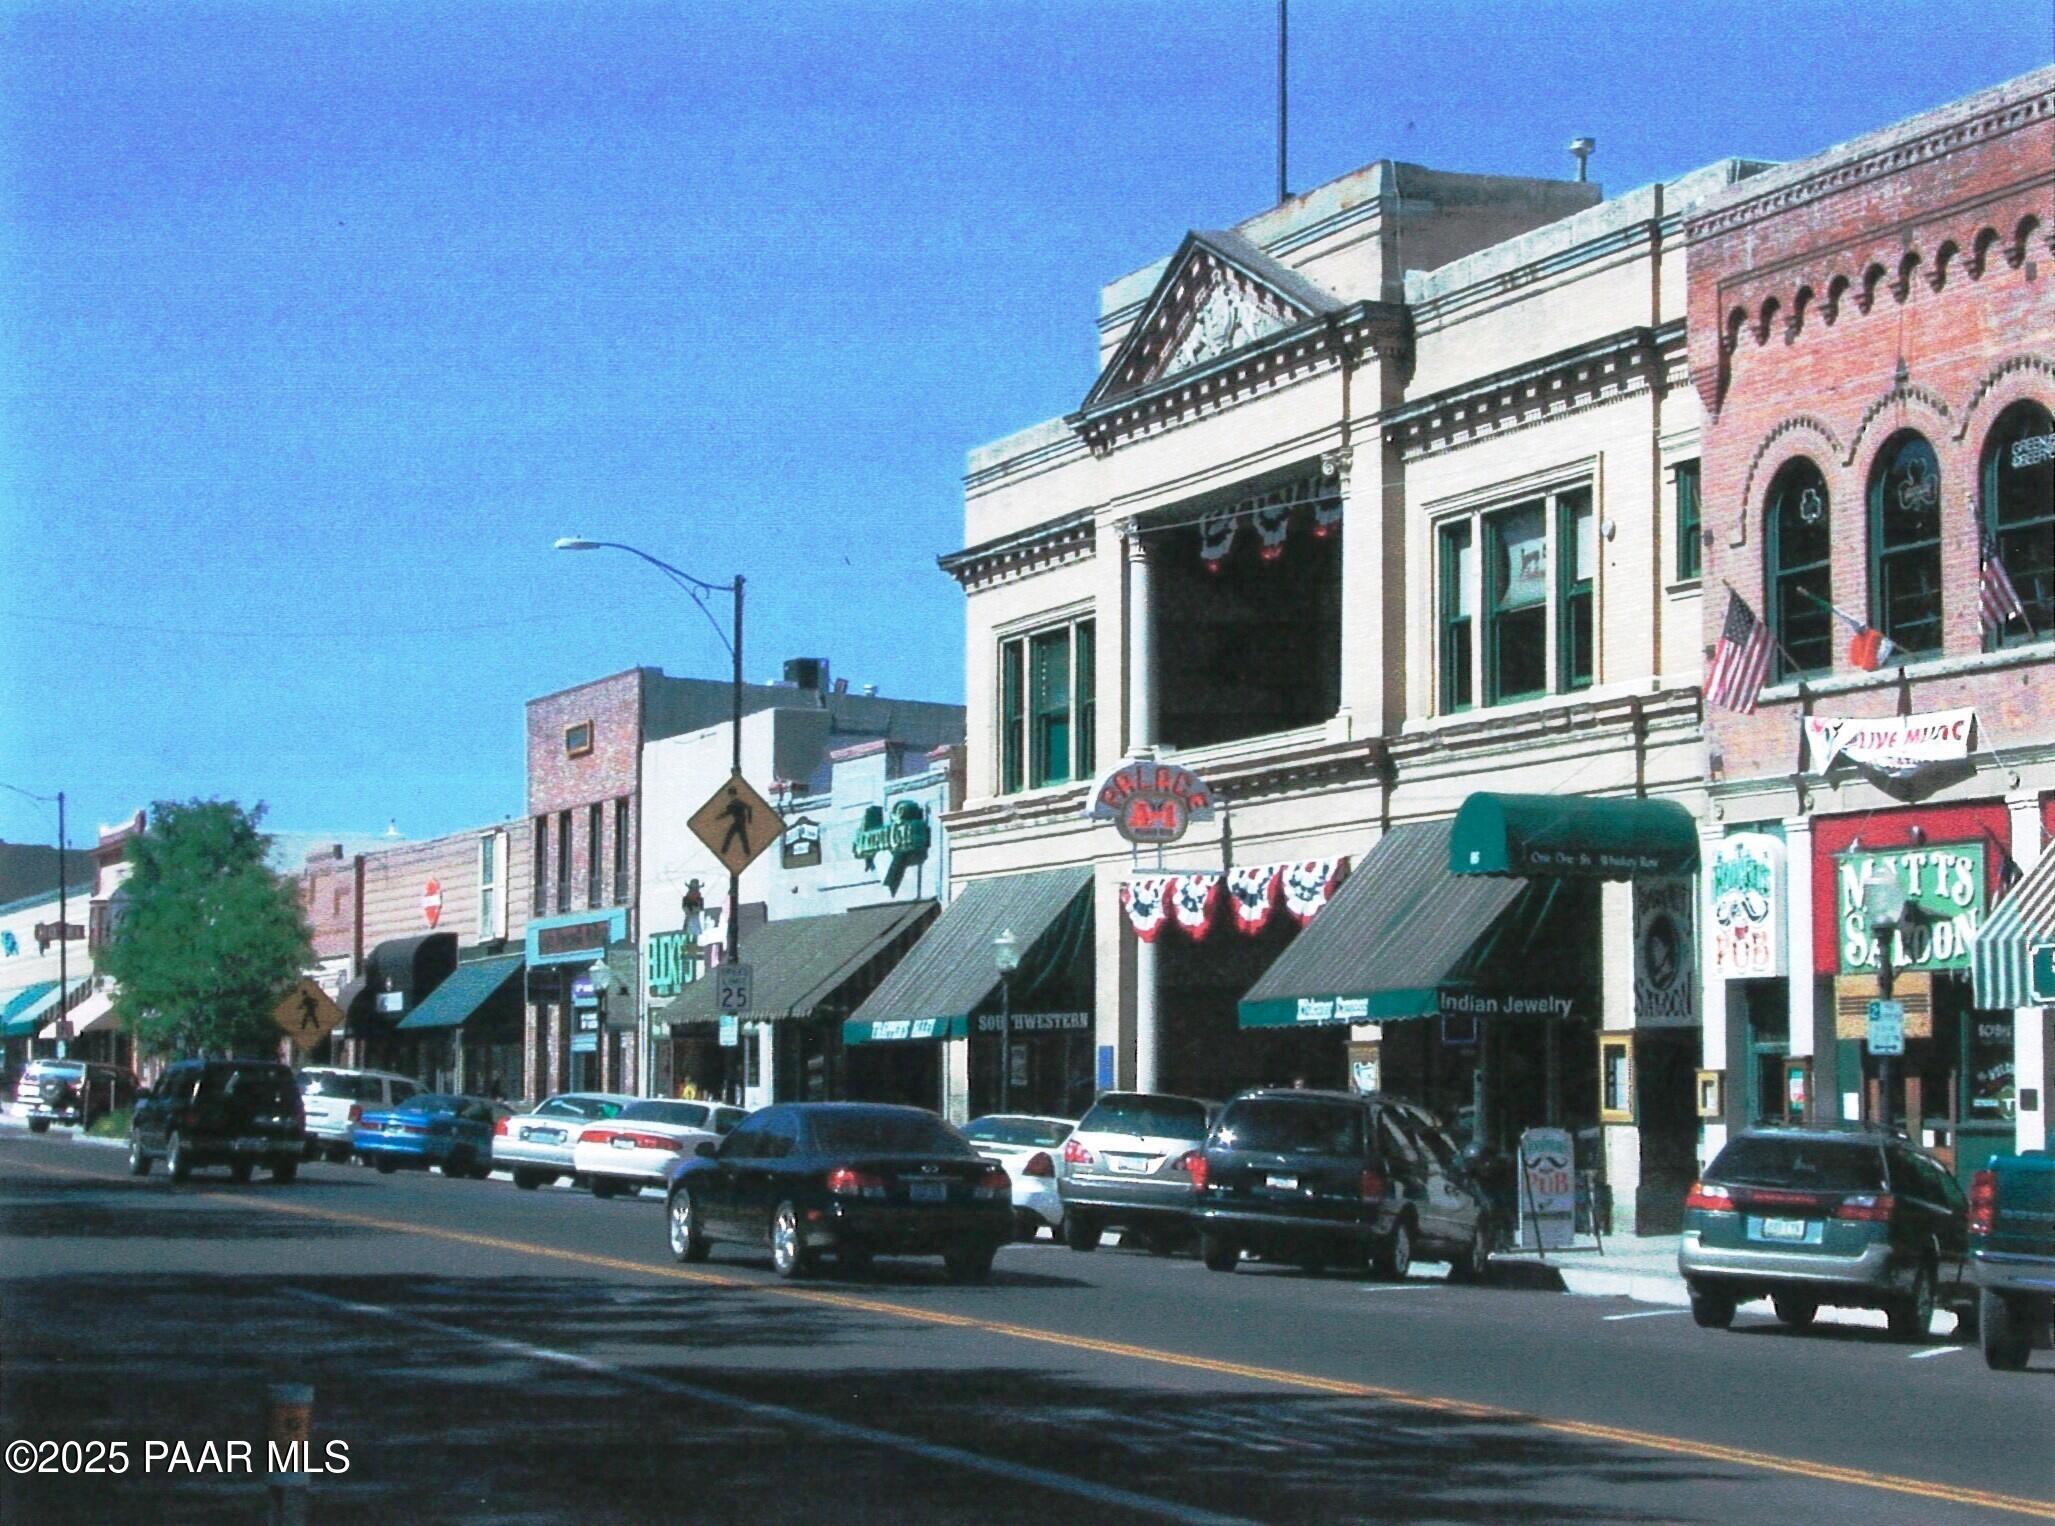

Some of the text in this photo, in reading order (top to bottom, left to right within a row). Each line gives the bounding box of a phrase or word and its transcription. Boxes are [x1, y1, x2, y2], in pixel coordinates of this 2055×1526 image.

[1101, 765, 1209, 812] PALACE
[722, 987, 747, 1008] 25
[1441, 992, 1573, 1018] Indian Jewelry
[979, 1012, 1089, 1032] SOUHWESTERN
[1526, 1171, 1569, 1197] PUB
